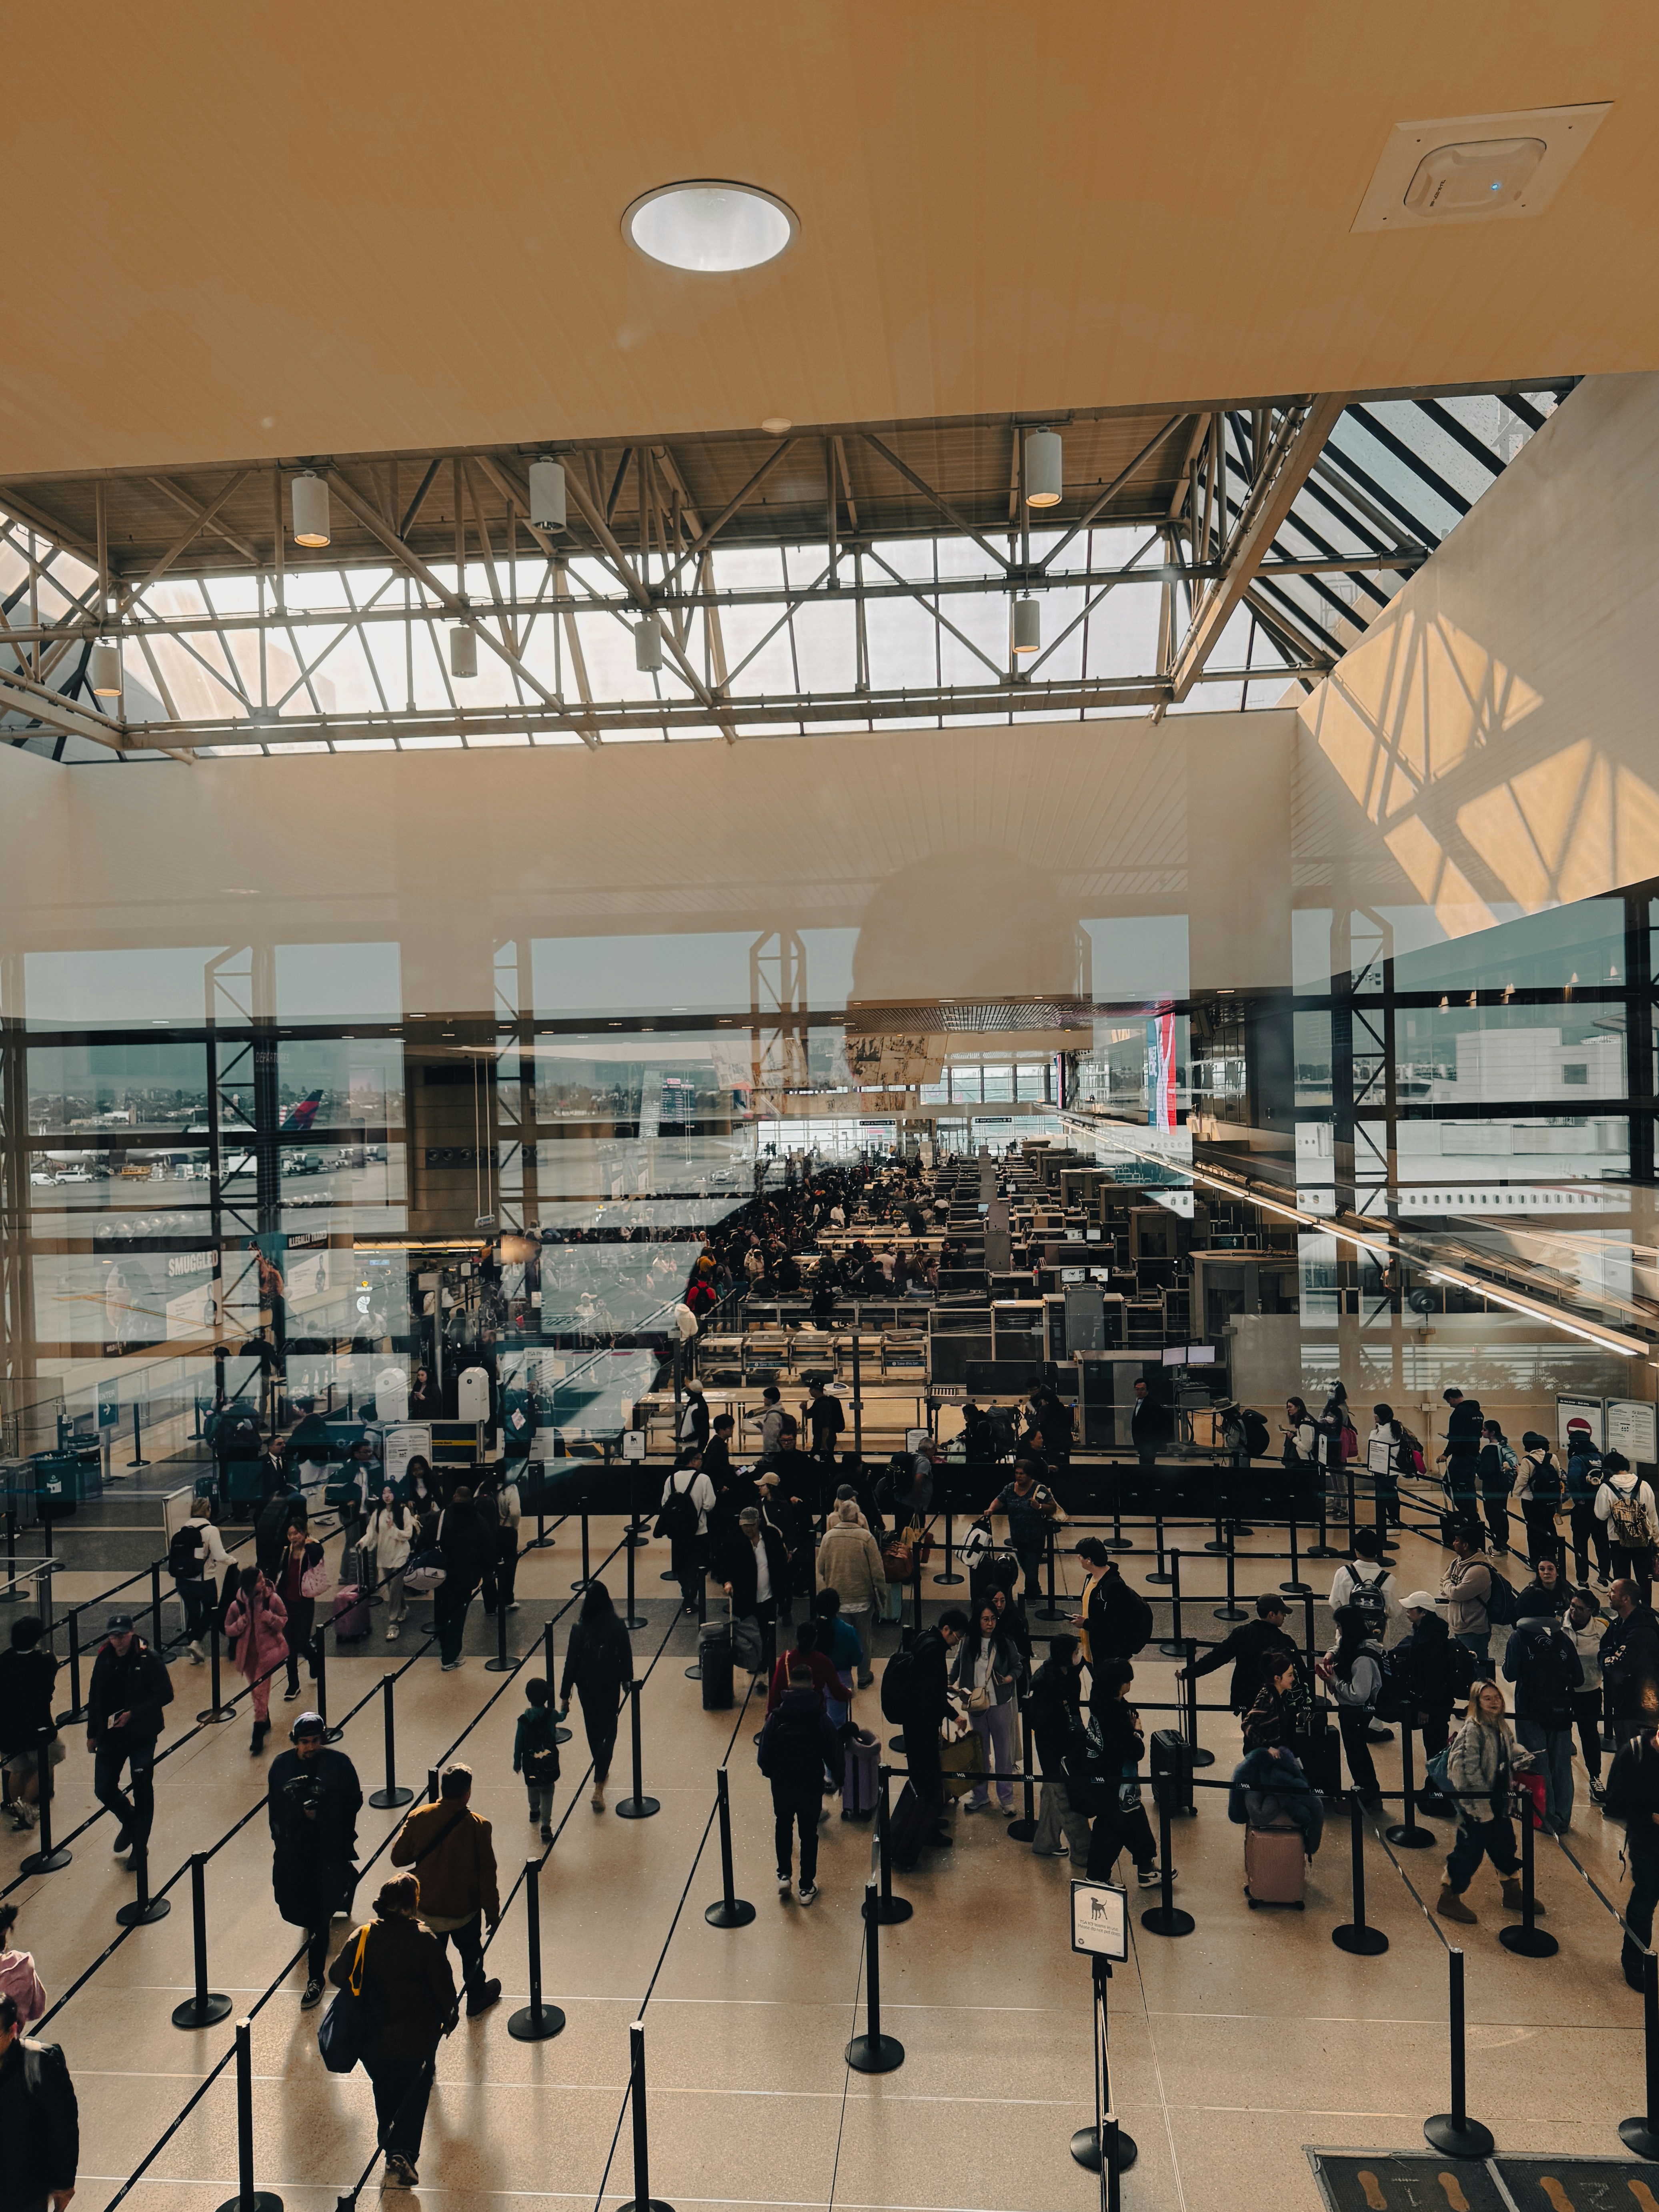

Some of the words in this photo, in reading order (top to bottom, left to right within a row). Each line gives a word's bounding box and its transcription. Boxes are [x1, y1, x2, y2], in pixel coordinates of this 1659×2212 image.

[256, 1052, 289, 1063] DEPARTURES
[288, 1233, 310, 1247] ILLEGALLY
[168, 1249, 218, 1277] SMUGGLED
[99, 1389, 115, 1401] ENTER
